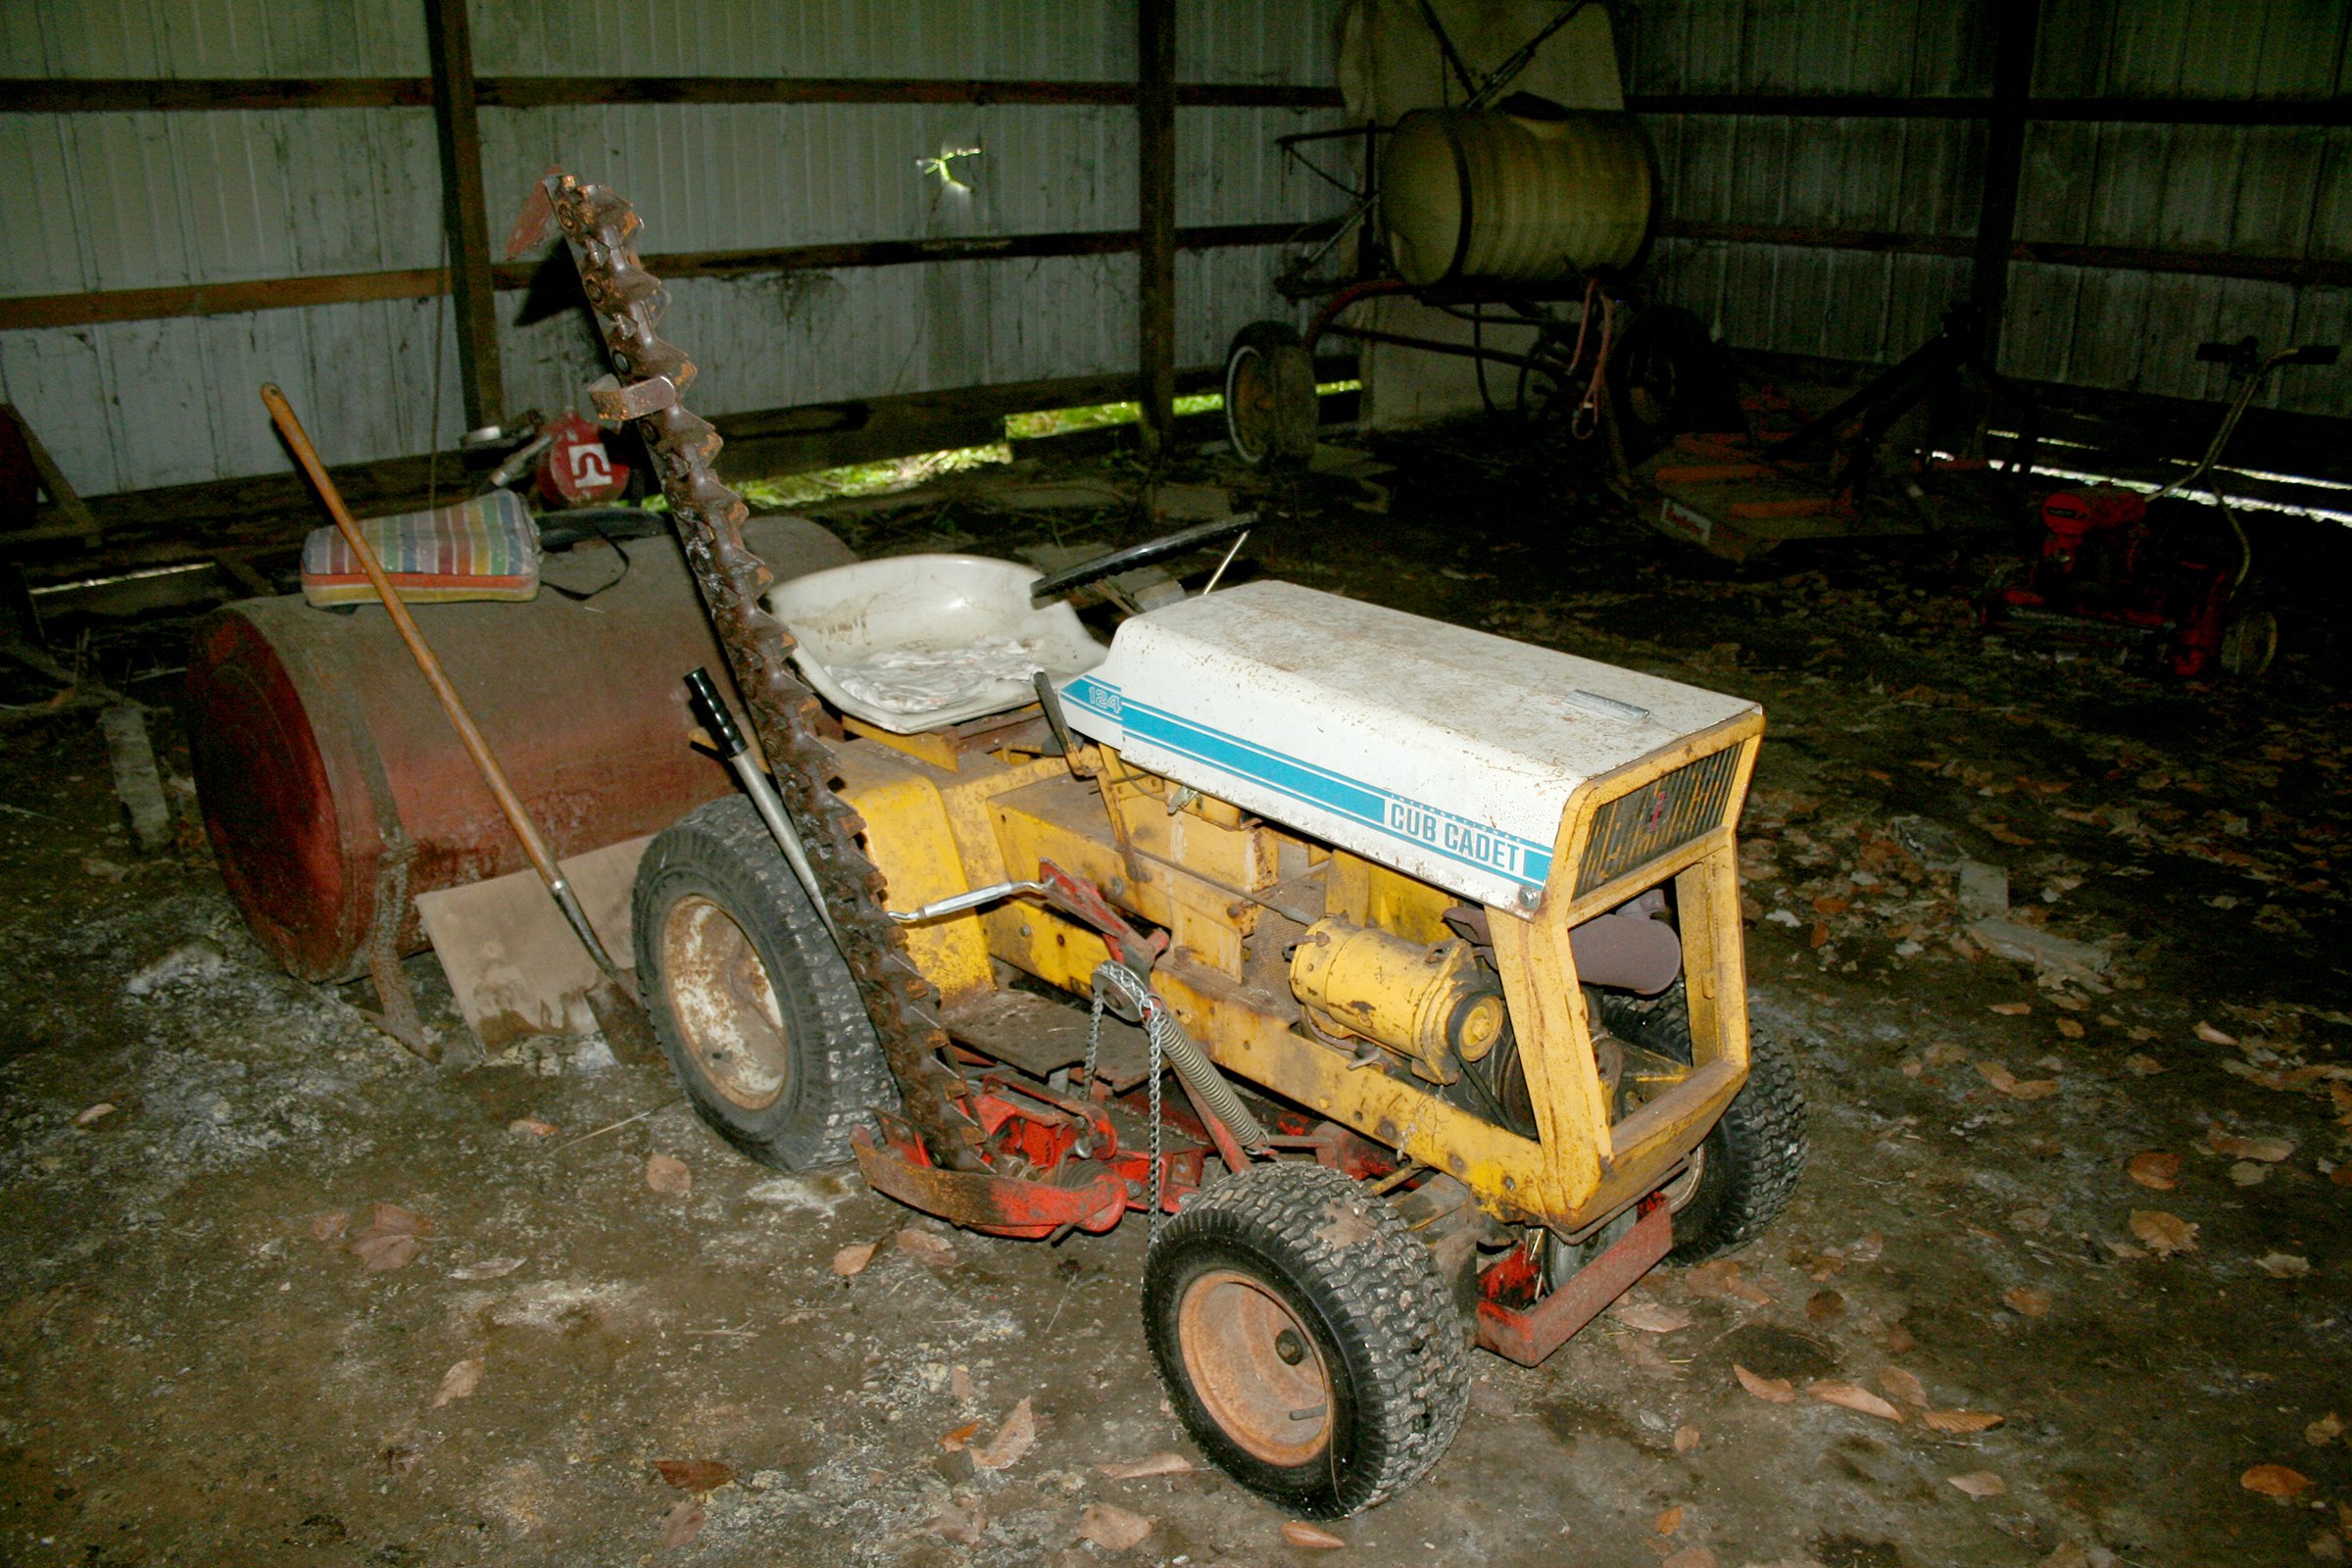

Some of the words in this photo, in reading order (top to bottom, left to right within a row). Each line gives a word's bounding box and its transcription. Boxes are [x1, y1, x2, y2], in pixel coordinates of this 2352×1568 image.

[1088, 685, 1122, 714] 124
[1390, 803, 1437, 843] CUB
[1444, 821, 1520, 872] CADET
